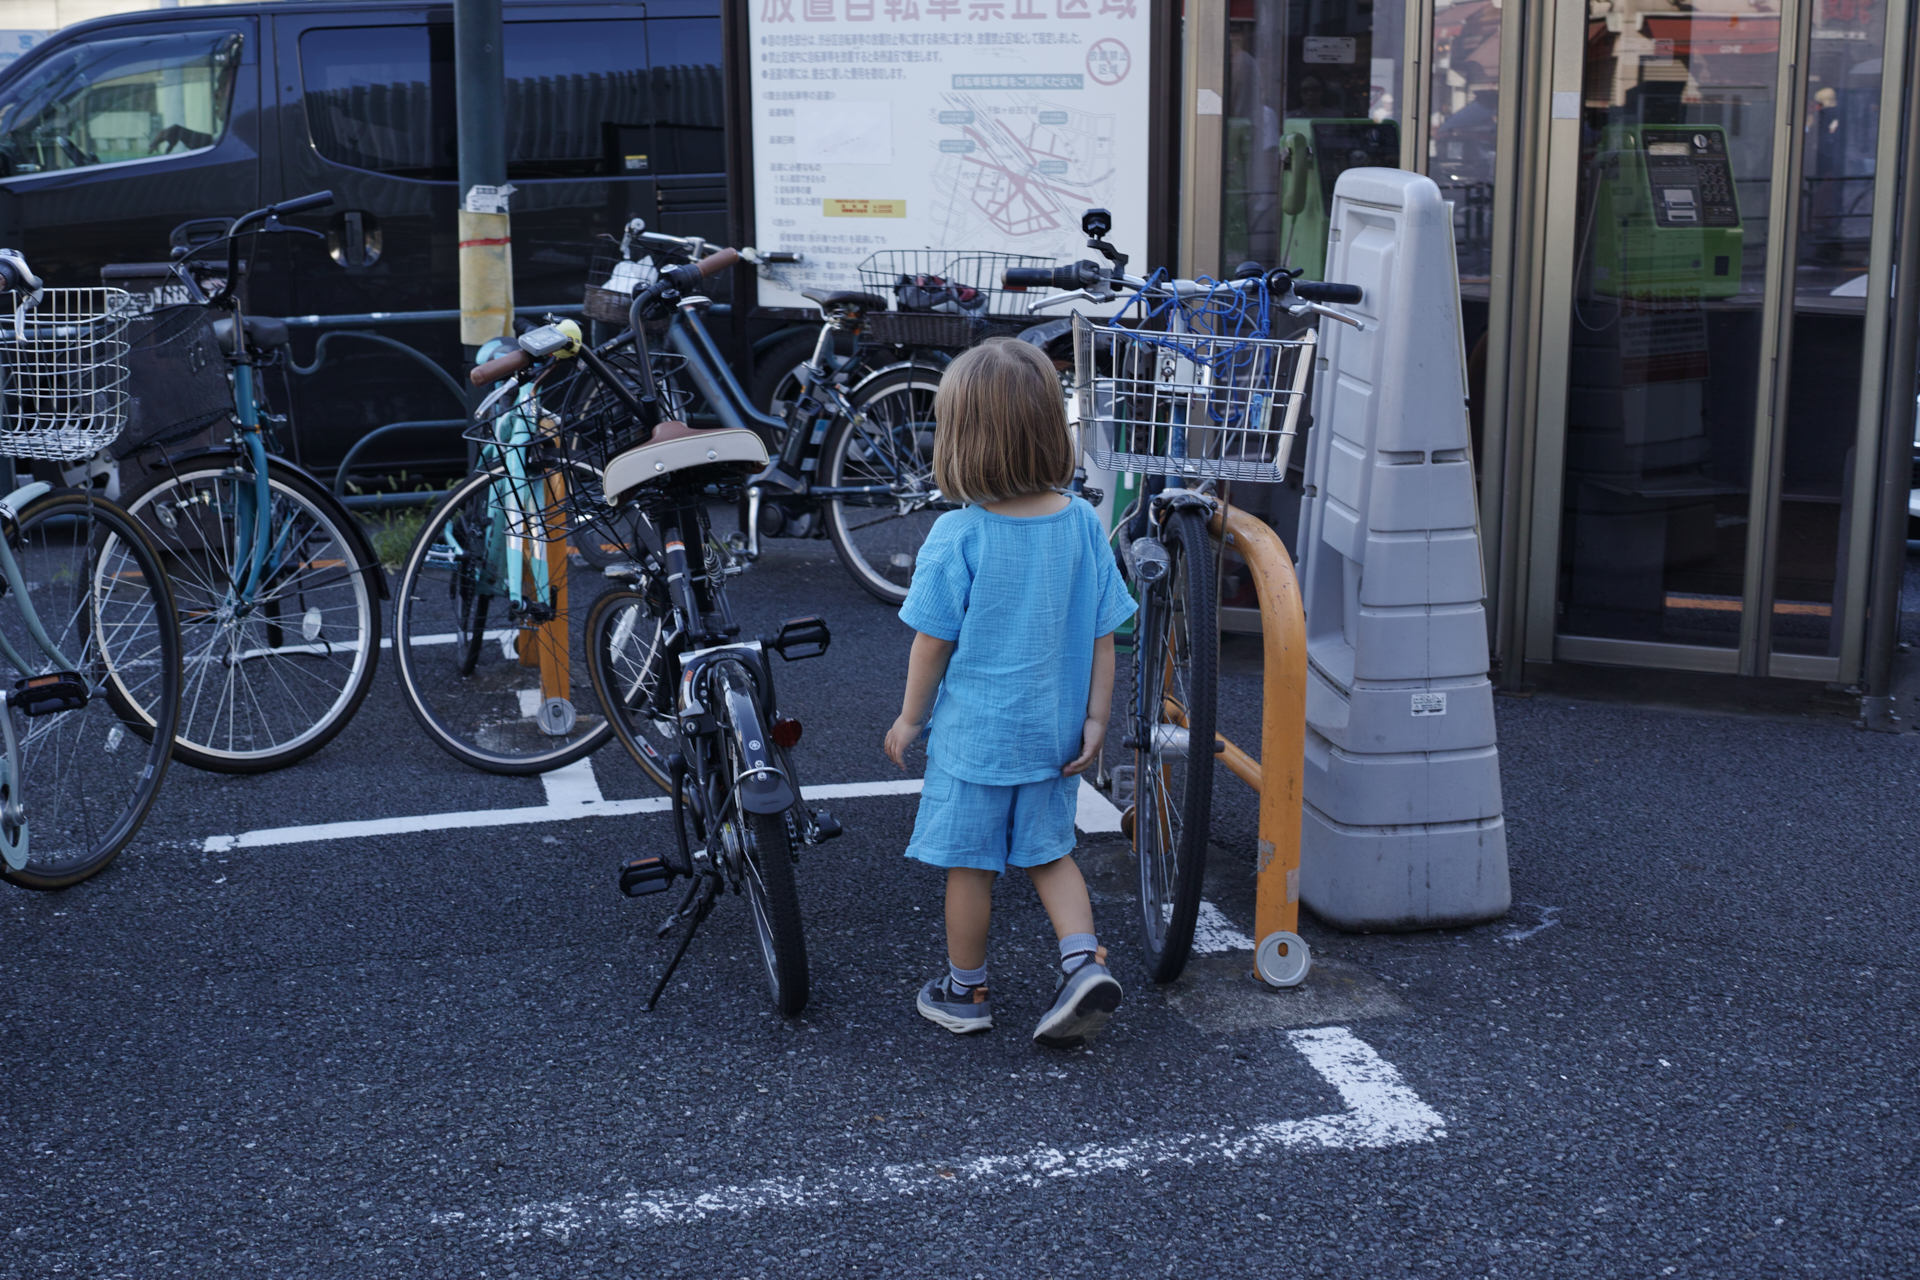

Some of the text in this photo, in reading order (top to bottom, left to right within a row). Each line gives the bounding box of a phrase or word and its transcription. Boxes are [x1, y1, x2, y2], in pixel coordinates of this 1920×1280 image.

[954, 76, 1082, 87] 自転車駐車場をご利用ください。
